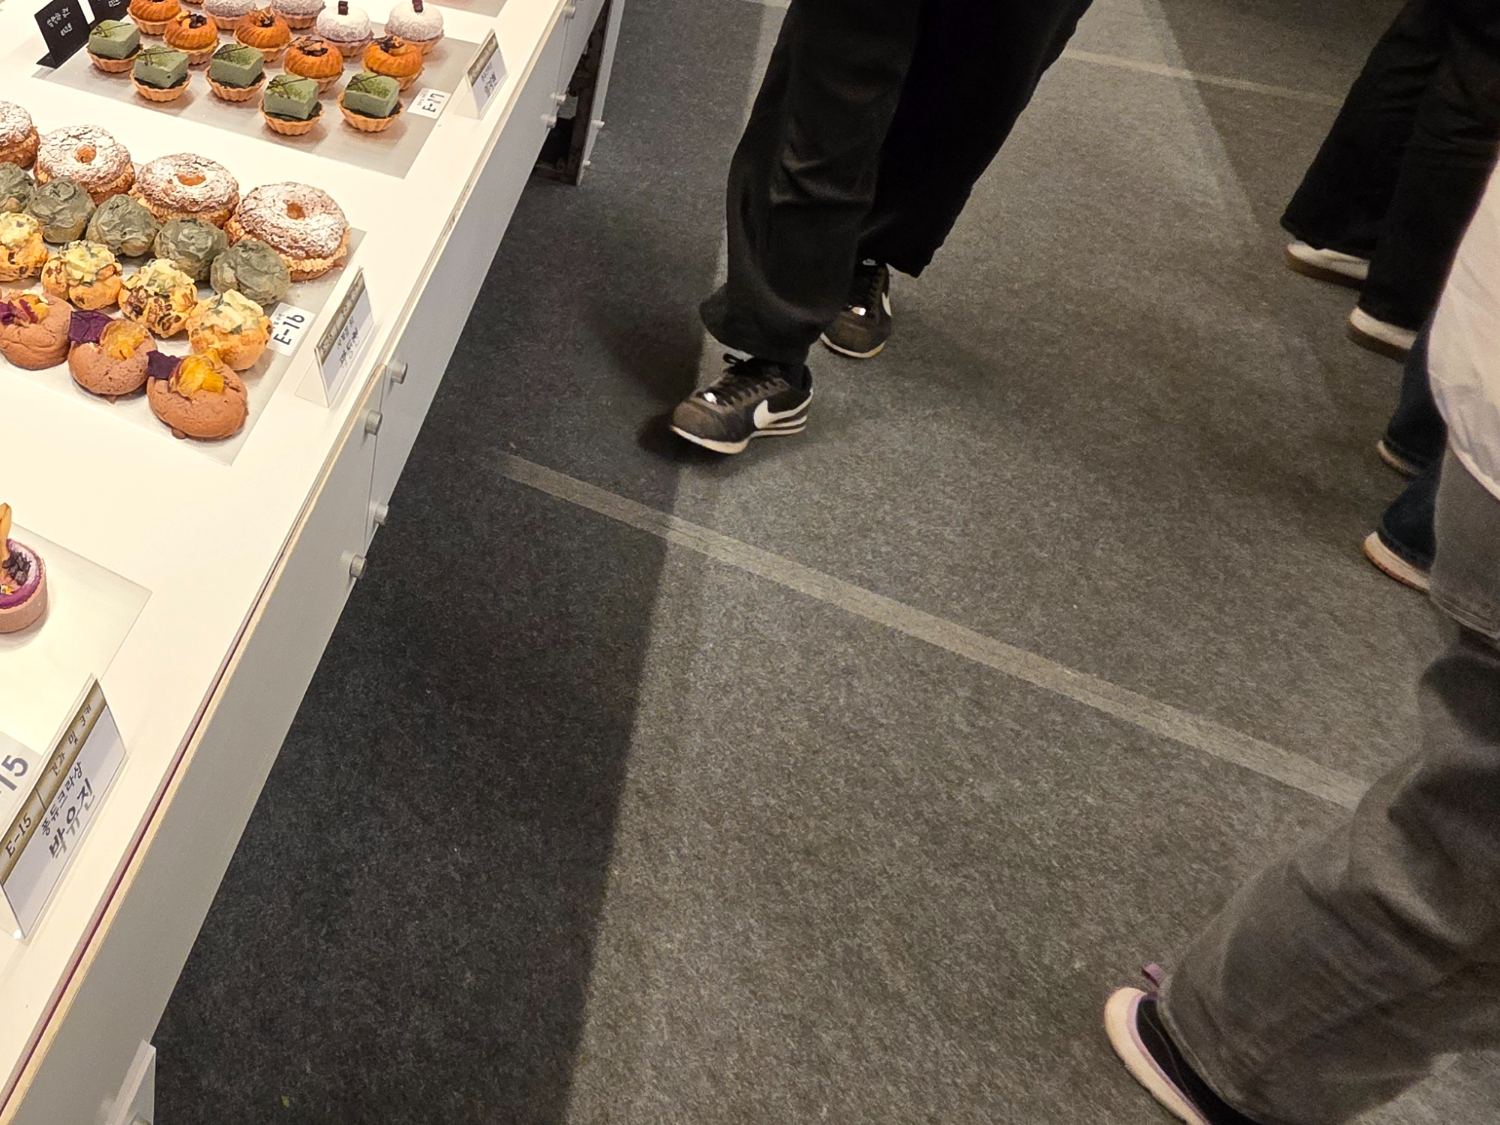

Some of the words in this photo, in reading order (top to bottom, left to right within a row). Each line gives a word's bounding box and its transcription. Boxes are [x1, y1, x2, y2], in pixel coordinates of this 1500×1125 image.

[422, 92, 445, 113] E-17
[273, 314, 305, 345] E-16
[6, 814, 32, 858] E-15
[50, 752, 66, 776] 견과
[68, 731, 79, 746] 및
[80, 704, 92, 727] 쿠키
[49, 778, 96, 859] 박유진
